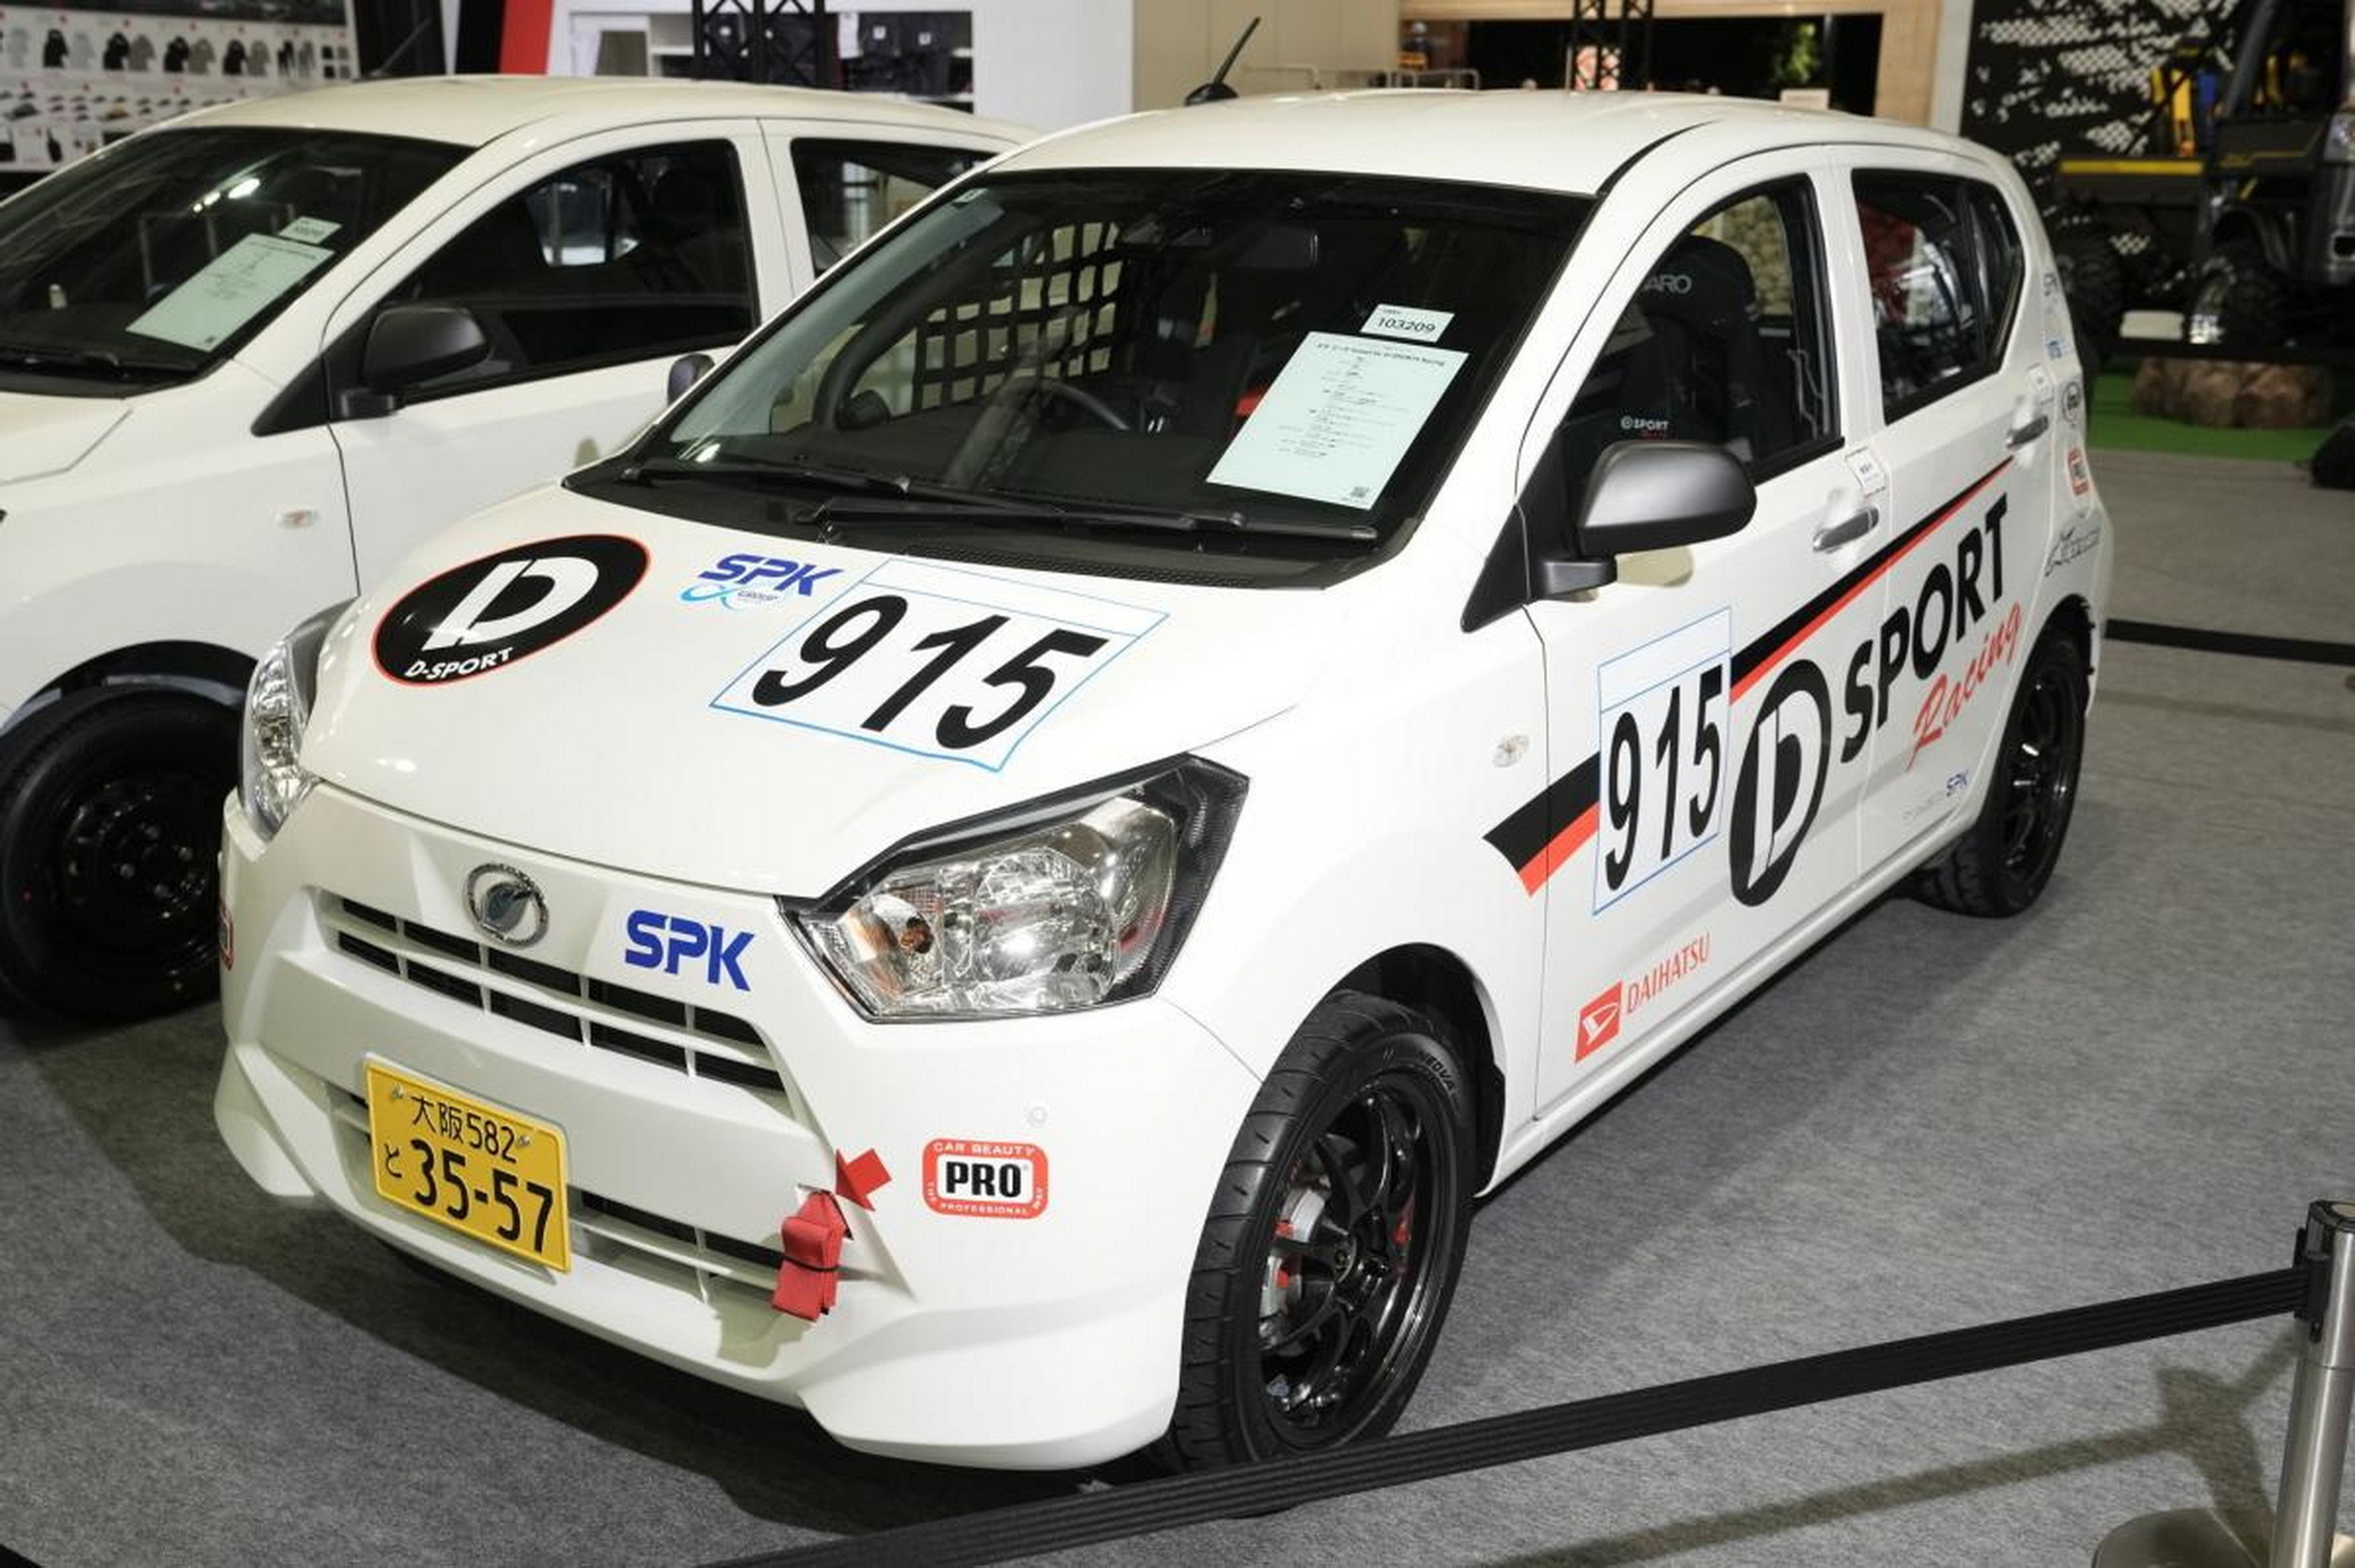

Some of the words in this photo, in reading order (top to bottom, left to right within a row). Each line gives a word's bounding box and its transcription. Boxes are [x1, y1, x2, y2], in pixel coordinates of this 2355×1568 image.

[1376, 316, 1437, 334] 103209
[698, 554, 845, 597] SPK
[404, 646, 514, 681] D-SPORT
[1840, 493, 2008, 764] SPORT
[753, 594, 1110, 750] 915
[1905, 602, 2022, 774] Racing
[1604, 664, 1723, 891] 915
[625, 910, 755, 992] SPK
[1627, 930, 1711, 1015] DAIHATSU
[383, 1142, 402, 1179] と
[933, 1141, 966, 1153] CAR
[971, 1143, 1035, 1156] BEAUTY
[946, 1161, 1021, 1198] PRO
[410, 1138, 554, 1253] 35-57
